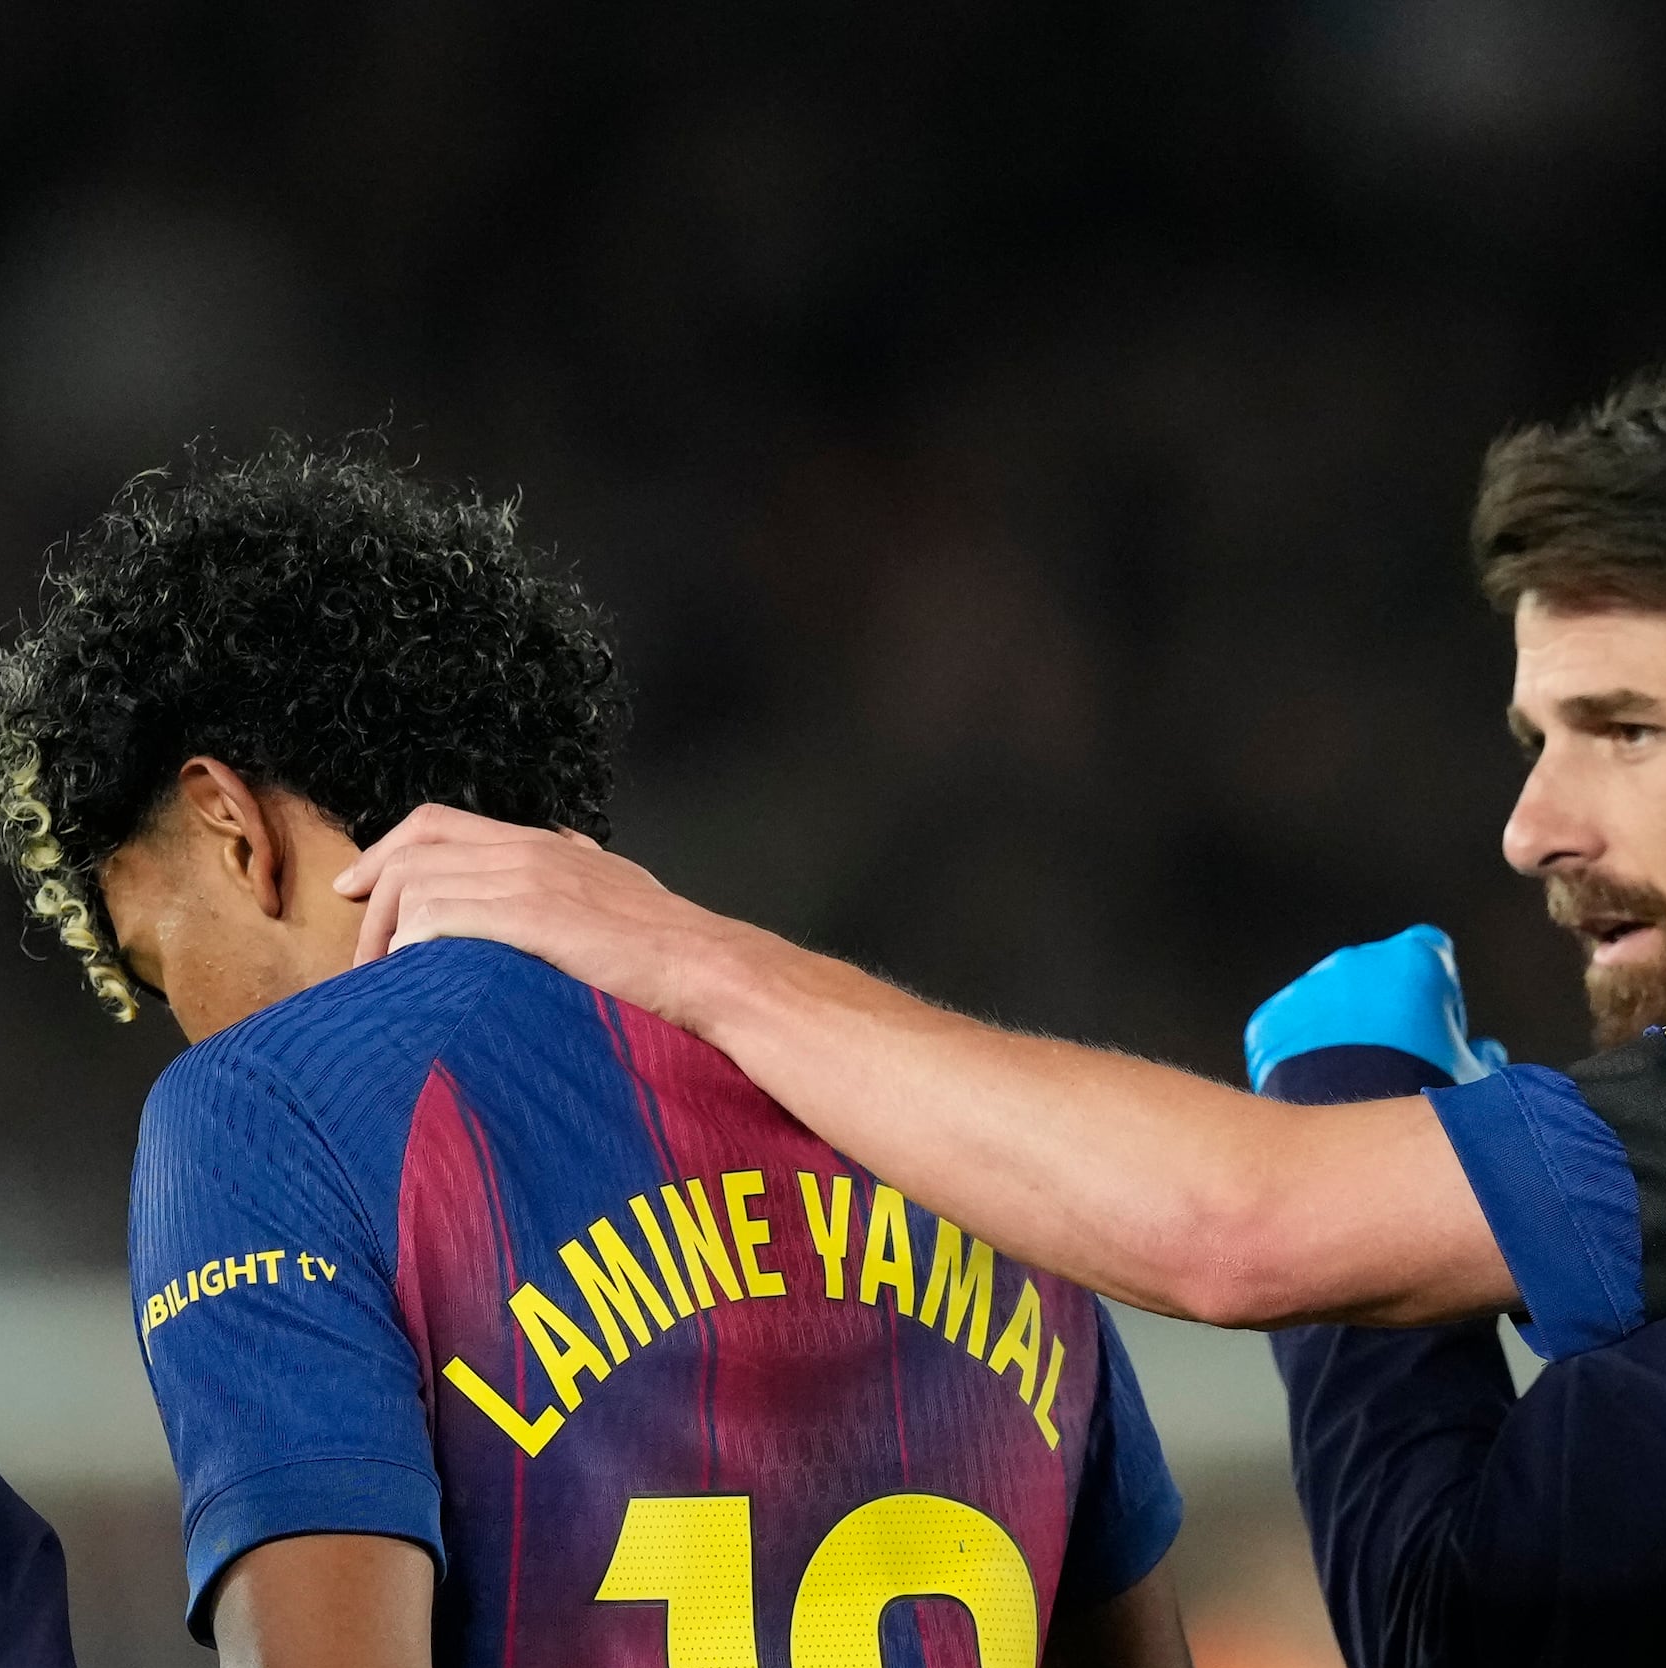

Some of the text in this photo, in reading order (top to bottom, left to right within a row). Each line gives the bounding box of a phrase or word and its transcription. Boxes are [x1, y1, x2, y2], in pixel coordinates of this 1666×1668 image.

[297, 1251, 336, 1282] tv
[441, 1170, 1065, 1458] LAMINE YAMAL
